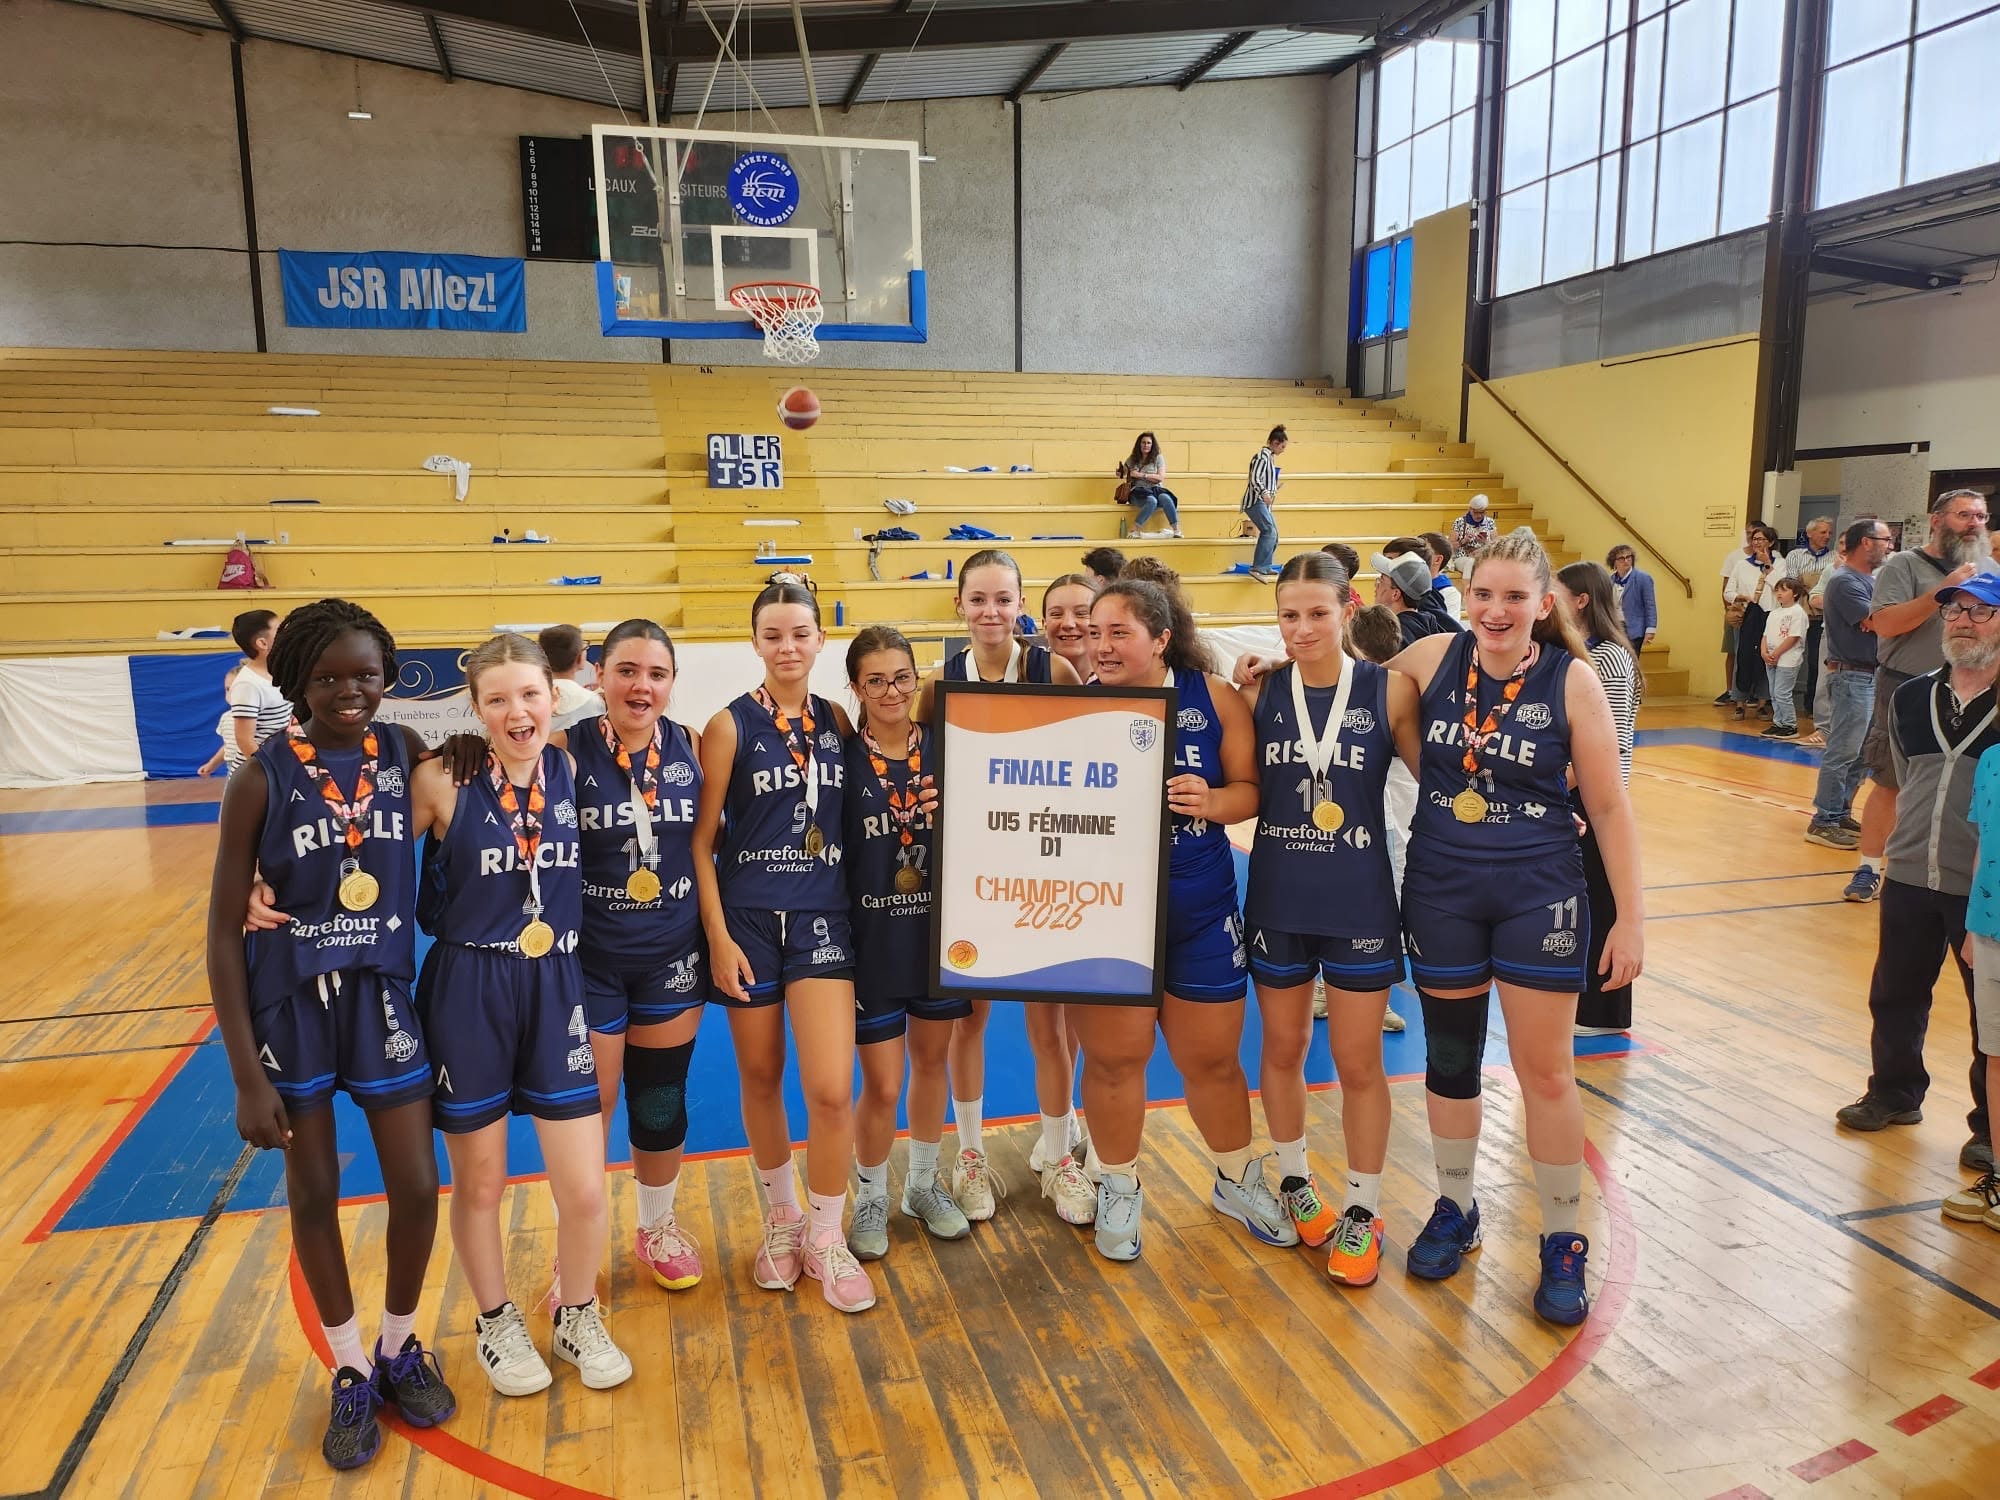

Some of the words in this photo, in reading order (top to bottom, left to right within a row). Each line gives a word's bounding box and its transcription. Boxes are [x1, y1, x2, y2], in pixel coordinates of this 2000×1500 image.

[529, 140, 534, 148] 4
[529, 148, 535, 156] 5
[735, 155, 768, 175] BASKET
[770, 157, 792, 177] CLUB
[528, 188, 538, 196] 10
[531, 180, 537, 188] 9
[588, 176, 637, 193] LCAUX
[680, 183, 728, 199] SITEURS
[528, 196, 538, 204] 11
[529, 204, 539, 212] 12
[735, 202, 747, 215] DU
[747, 204, 795, 225] MIRANDAIS
[530, 220, 540, 228] 14
[531, 228, 540, 236] 15
[318, 267, 388, 309] JSR
[399, 268, 497, 313] Allez!
[709, 435, 781, 460] ALLER
[373, 711, 390, 723] pes
[393, 709, 441, 721] Funèbres
[1177, 715, 1203, 723] ISCLE
[1343, 715, 1370, 724] RISCLE
[1517, 709, 1548, 720] RISCLE
[1426, 719, 1537, 767] RICLE
[1265, 740, 1366, 771] RISLE
[752, 763, 844, 796] RISLE
[1083, 761, 1120, 789] AB
[1430, 791, 1509, 813] Carur
[792, 801, 807, 834] 9
[987, 810, 1021, 832] U15
[292, 810, 404, 858] RILE
[1040, 836, 1062, 857] D1
[1285, 841, 1337, 853] contact
[766, 862, 815, 873] contact
[581, 880, 663, 899] Carre
[975, 875, 1125, 907] CHAMPION
[608, 899, 664, 911] contact
[1546, 896, 1577, 928] 11
[1014, 900, 1084, 930] 2026
[813, 916, 830, 946] 9
[316, 933, 379, 949] contact
[1542, 938, 1574, 946] RISCLE
[812, 951, 841, 960] RISCLE
[568, 1004, 589, 1044] 4
